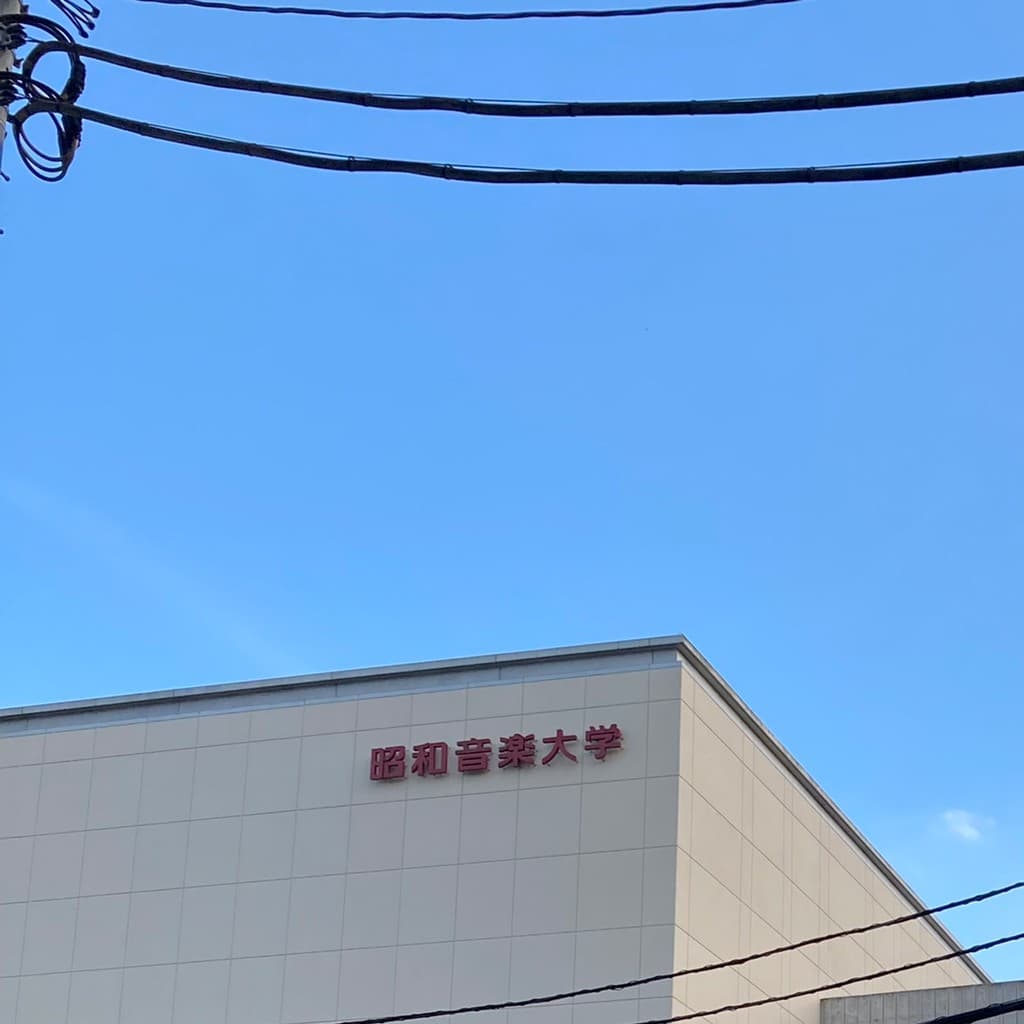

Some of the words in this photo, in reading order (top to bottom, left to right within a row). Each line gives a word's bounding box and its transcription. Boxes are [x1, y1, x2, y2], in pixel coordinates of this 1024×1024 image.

[370, 723, 624, 781] 昭和音楽大学
